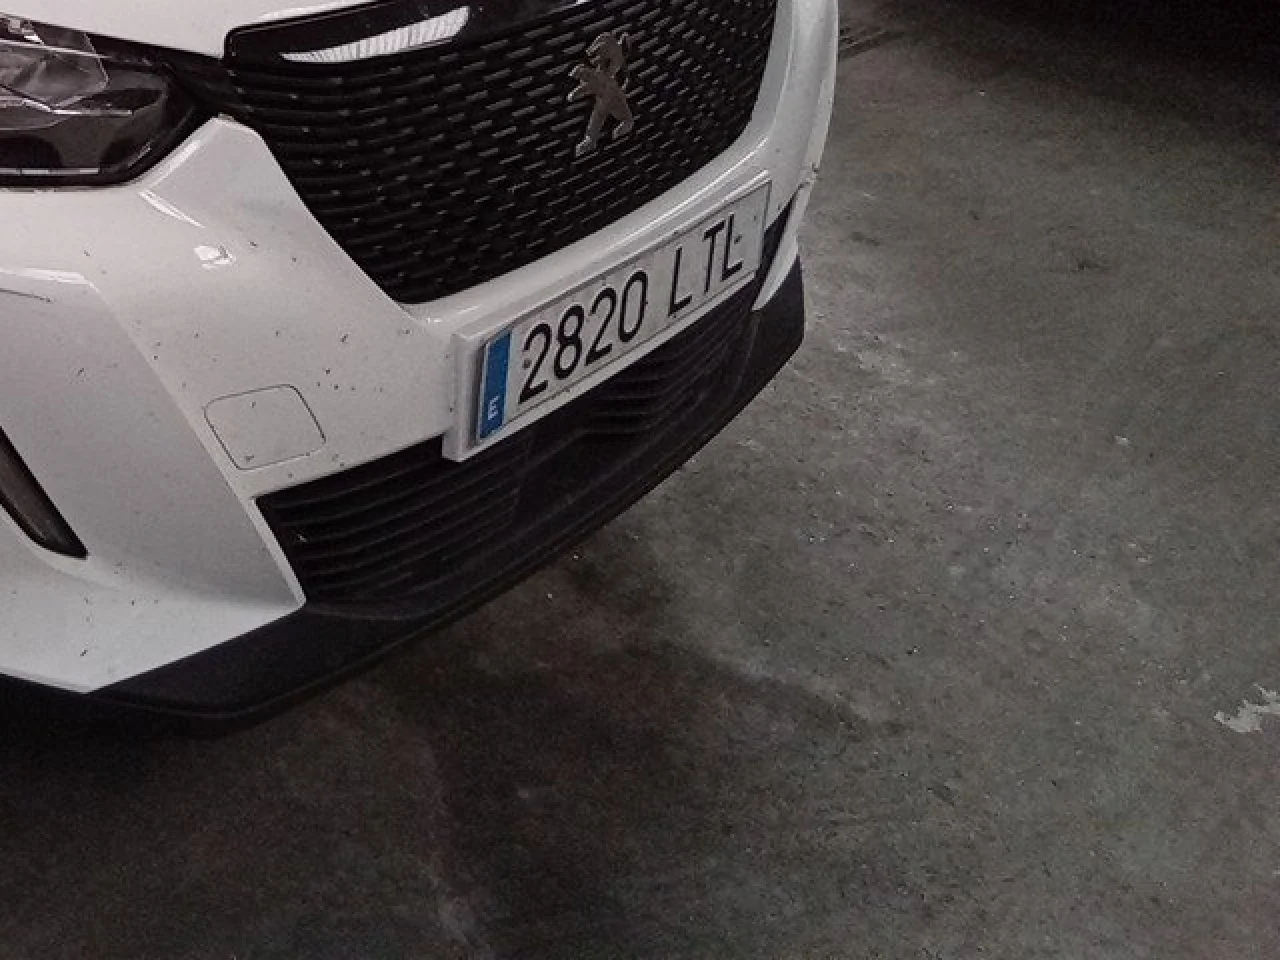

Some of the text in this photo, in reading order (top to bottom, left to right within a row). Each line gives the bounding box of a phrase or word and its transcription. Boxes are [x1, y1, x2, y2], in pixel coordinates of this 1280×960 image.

[487, 213, 744, 420] E 2820 LTL
